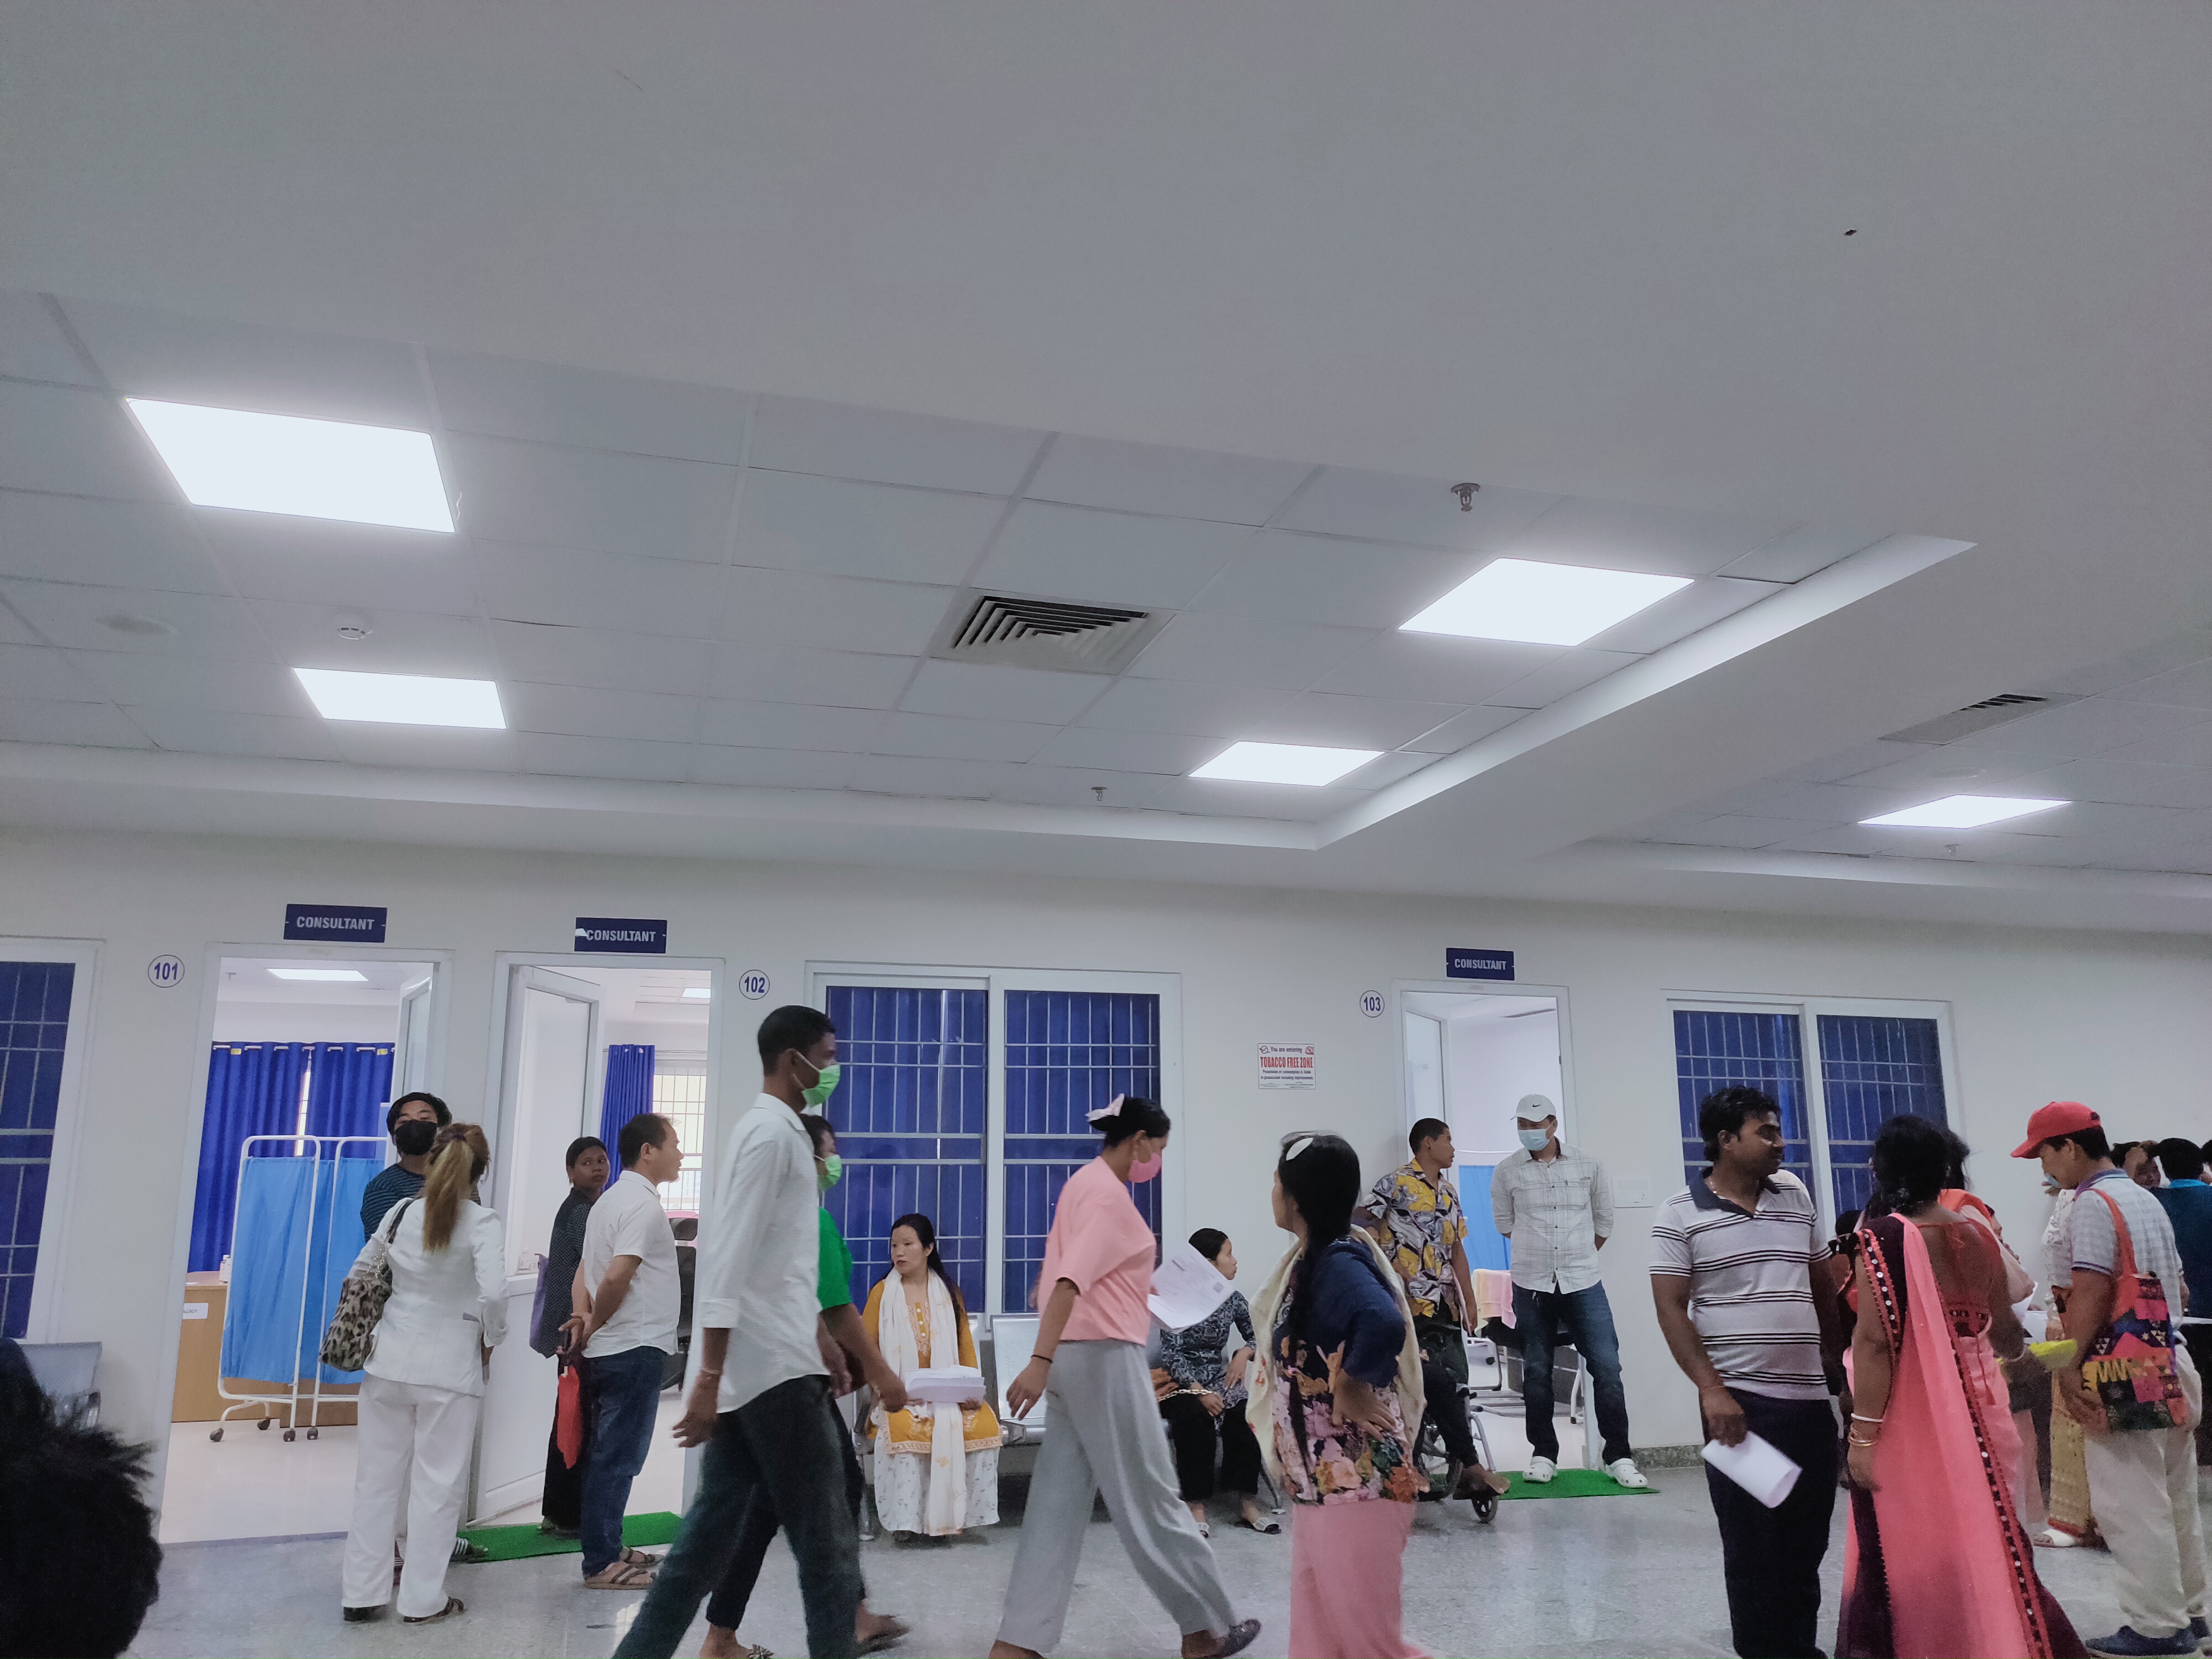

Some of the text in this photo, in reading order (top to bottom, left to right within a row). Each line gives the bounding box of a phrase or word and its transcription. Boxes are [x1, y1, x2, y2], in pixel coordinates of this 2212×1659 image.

[296, 916, 375, 930] CONSULTANT
[586, 930, 656, 942] CONSULTANT
[154, 962, 178, 980] 101
[1454, 958, 1506, 970] CONSULTANT
[744, 976, 765, 993] 102
[1364, 996, 1381, 1011] 103
[1260, 1057, 1313, 1068] TOBACCO FREE ZONE
